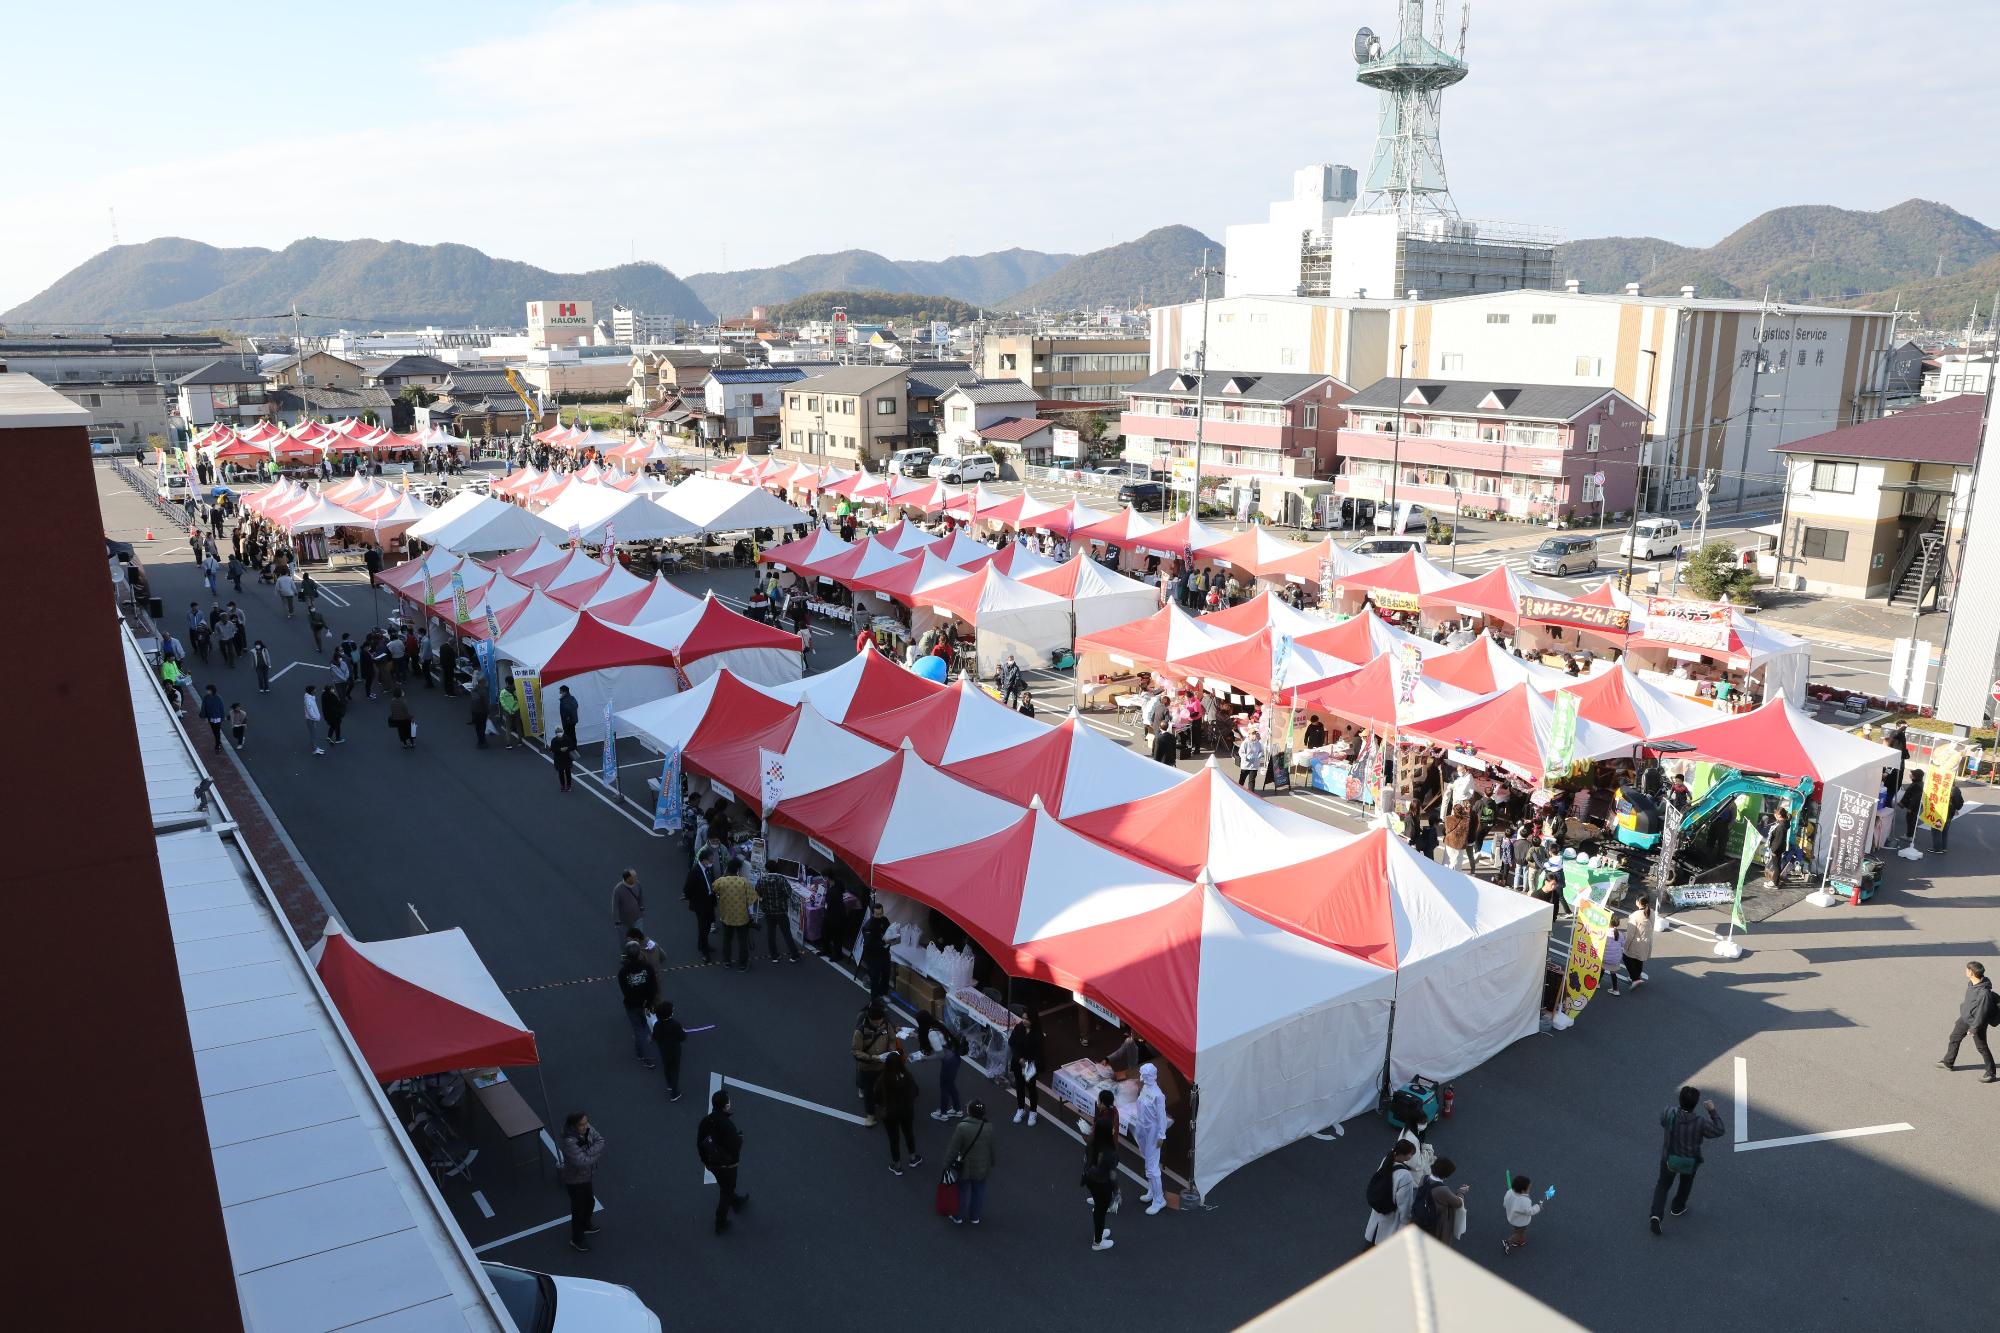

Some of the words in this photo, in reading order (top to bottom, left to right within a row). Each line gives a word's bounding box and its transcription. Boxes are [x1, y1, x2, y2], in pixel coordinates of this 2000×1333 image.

[1796, 327, 1827, 340] Service
[1533, 601, 1606, 623] ホルモンうどん
[1843, 793, 1873, 809] STAFF
[1842, 803, 1870, 818] 大募集
[1577, 921, 1606, 940] フルーツ
[1573, 954, 1600, 973] ドリンク
